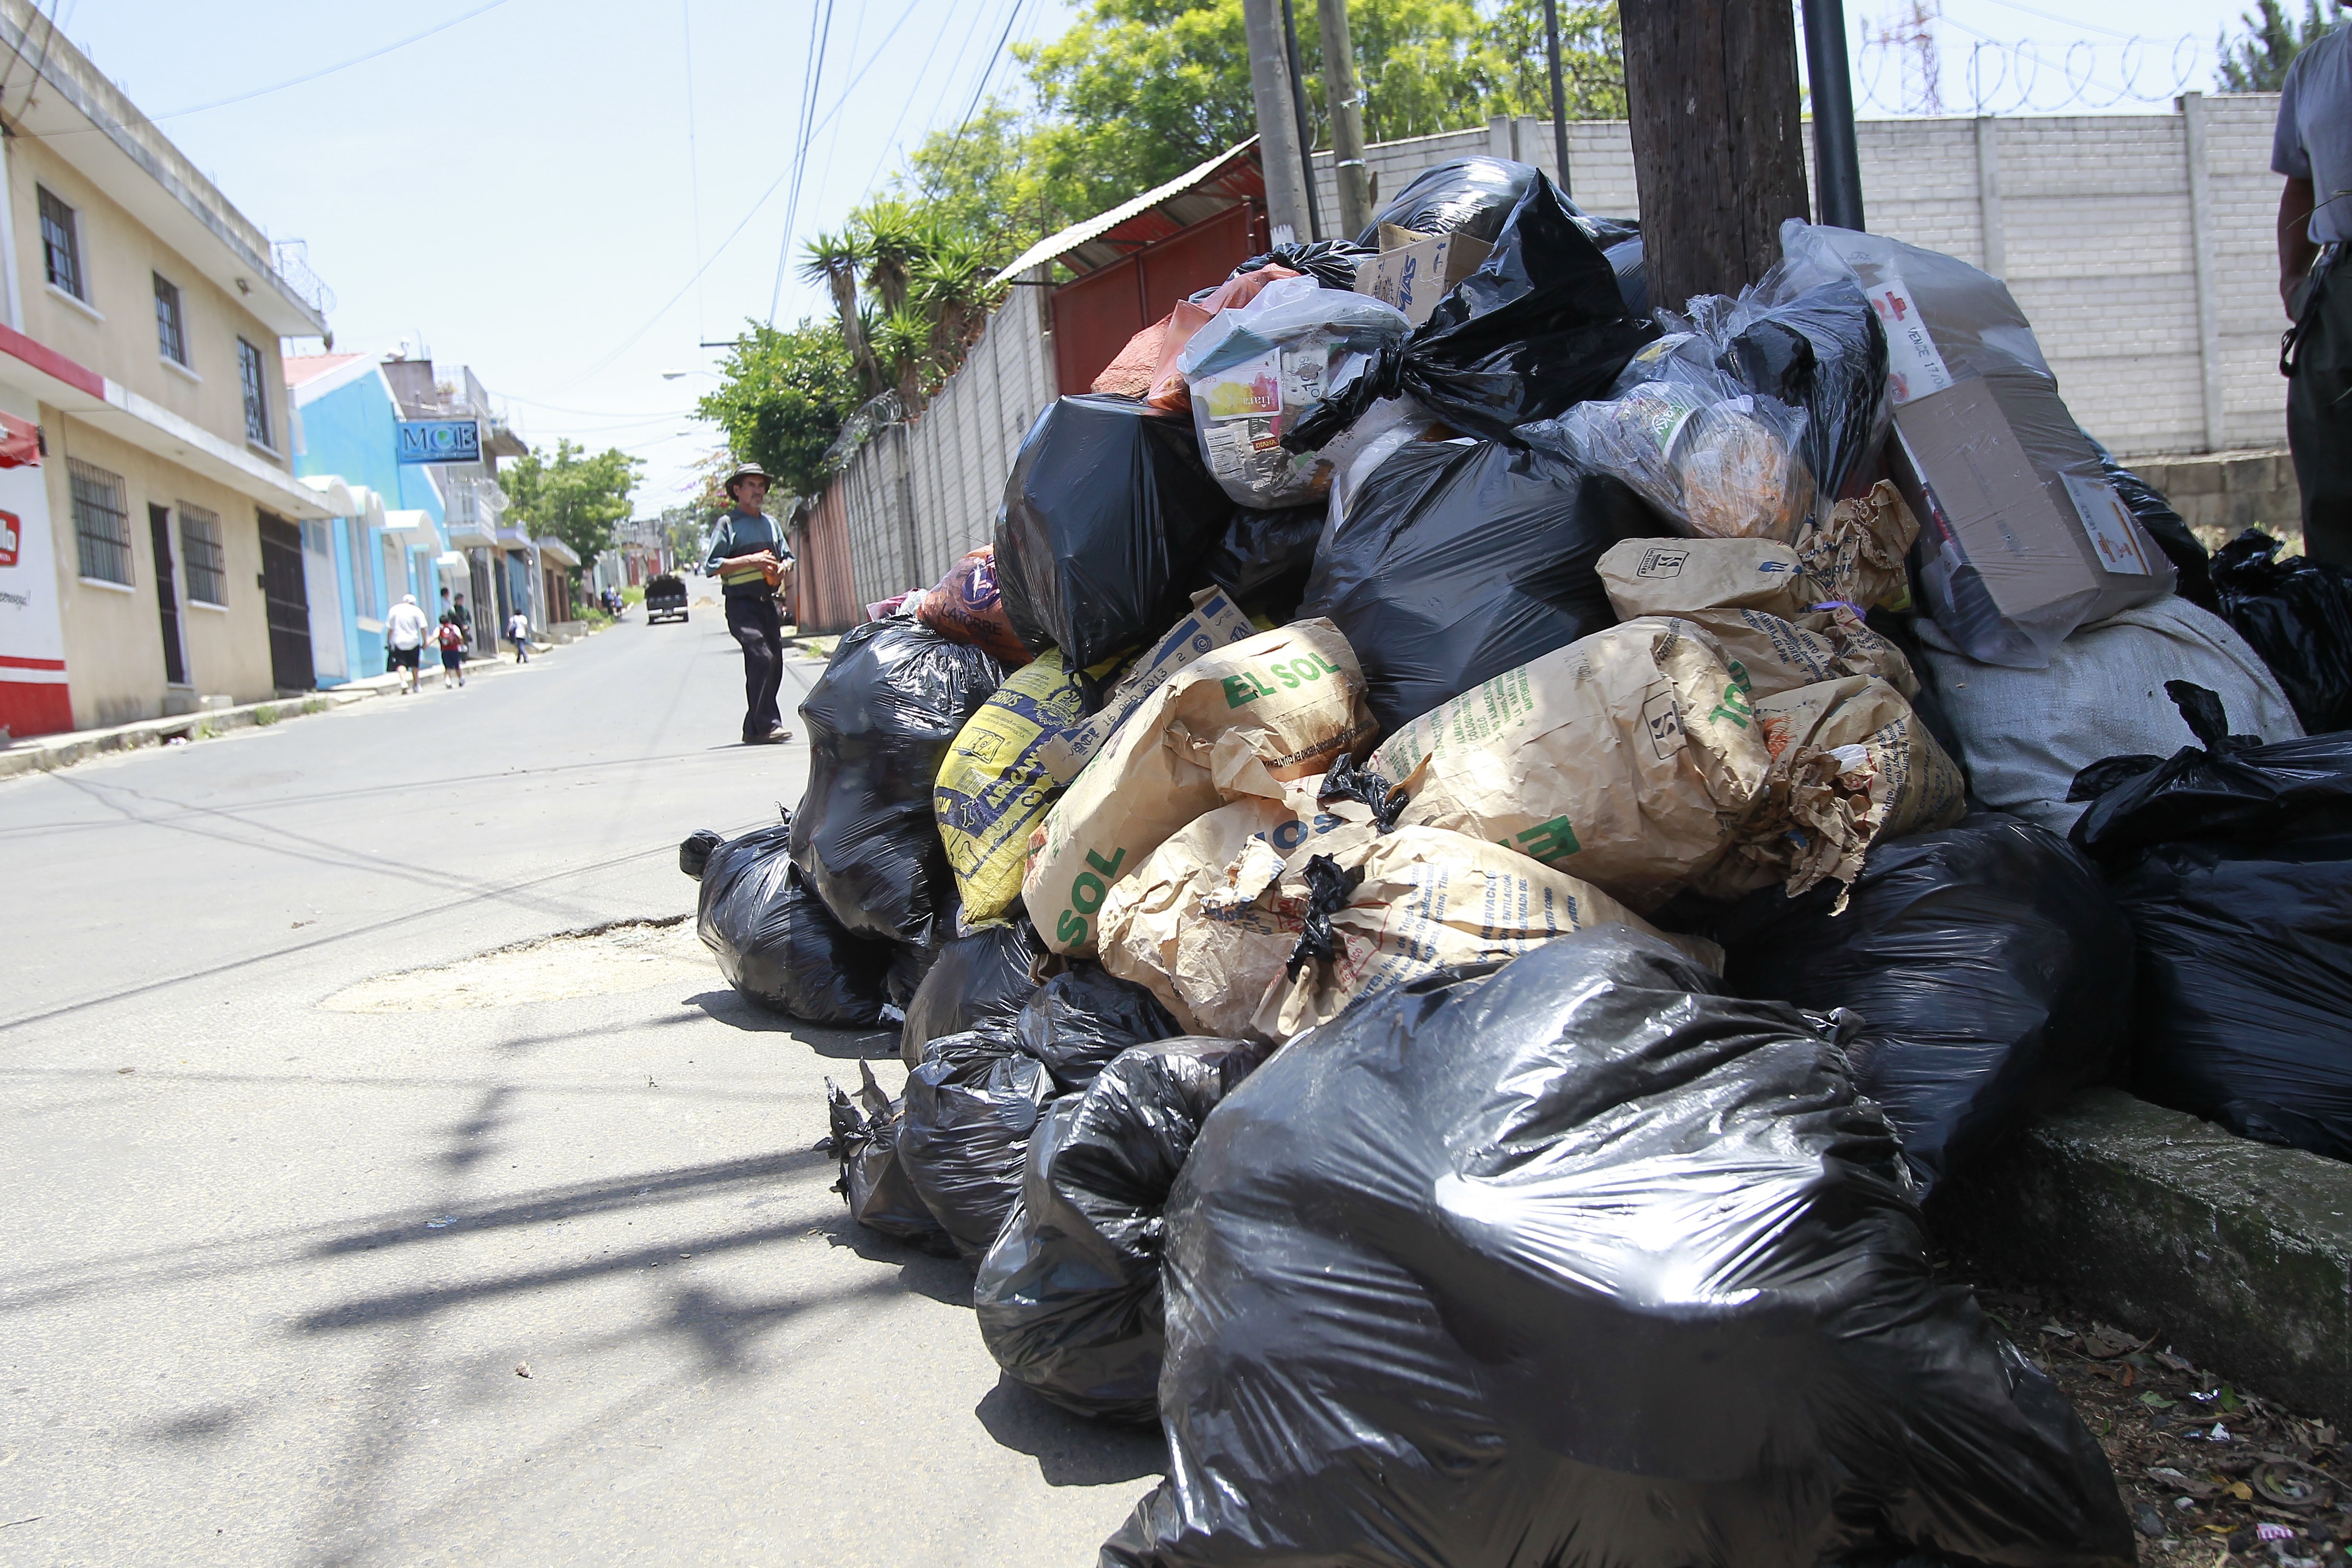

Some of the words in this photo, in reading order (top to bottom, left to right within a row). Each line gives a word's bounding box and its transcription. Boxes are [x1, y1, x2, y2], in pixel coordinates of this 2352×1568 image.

[1908, 327, 1929, 358] VENCE
[1242, 395, 1270, 407] tiara
[1255, 439, 1277, 449] DIANA
[1773, 639, 1783, 649] EL
[1800, 633, 1819, 653] JUNTO
[1777, 649, 1790, 665] PAN.
[1102, 714, 1116, 727] 16
[1140, 668, 1167, 693] 2013
[1176, 652, 1186, 662] 2
[1221, 672, 1277, 709] EL
[1270, 652, 1342, 688] SOL
[991, 690, 1023, 707] ERROS
[1058, 698, 1073, 708] años
[1293, 751, 1302, 762] EN
[1882, 788, 1895, 812] Trigo,
[1497, 815, 1581, 862] E
[1519, 878, 1528, 892] DEL
[1057, 847, 1127, 948] SOL
[1518, 894, 1529, 930] SEPARADA
[1568, 894, 1580, 924] PUEDEN
